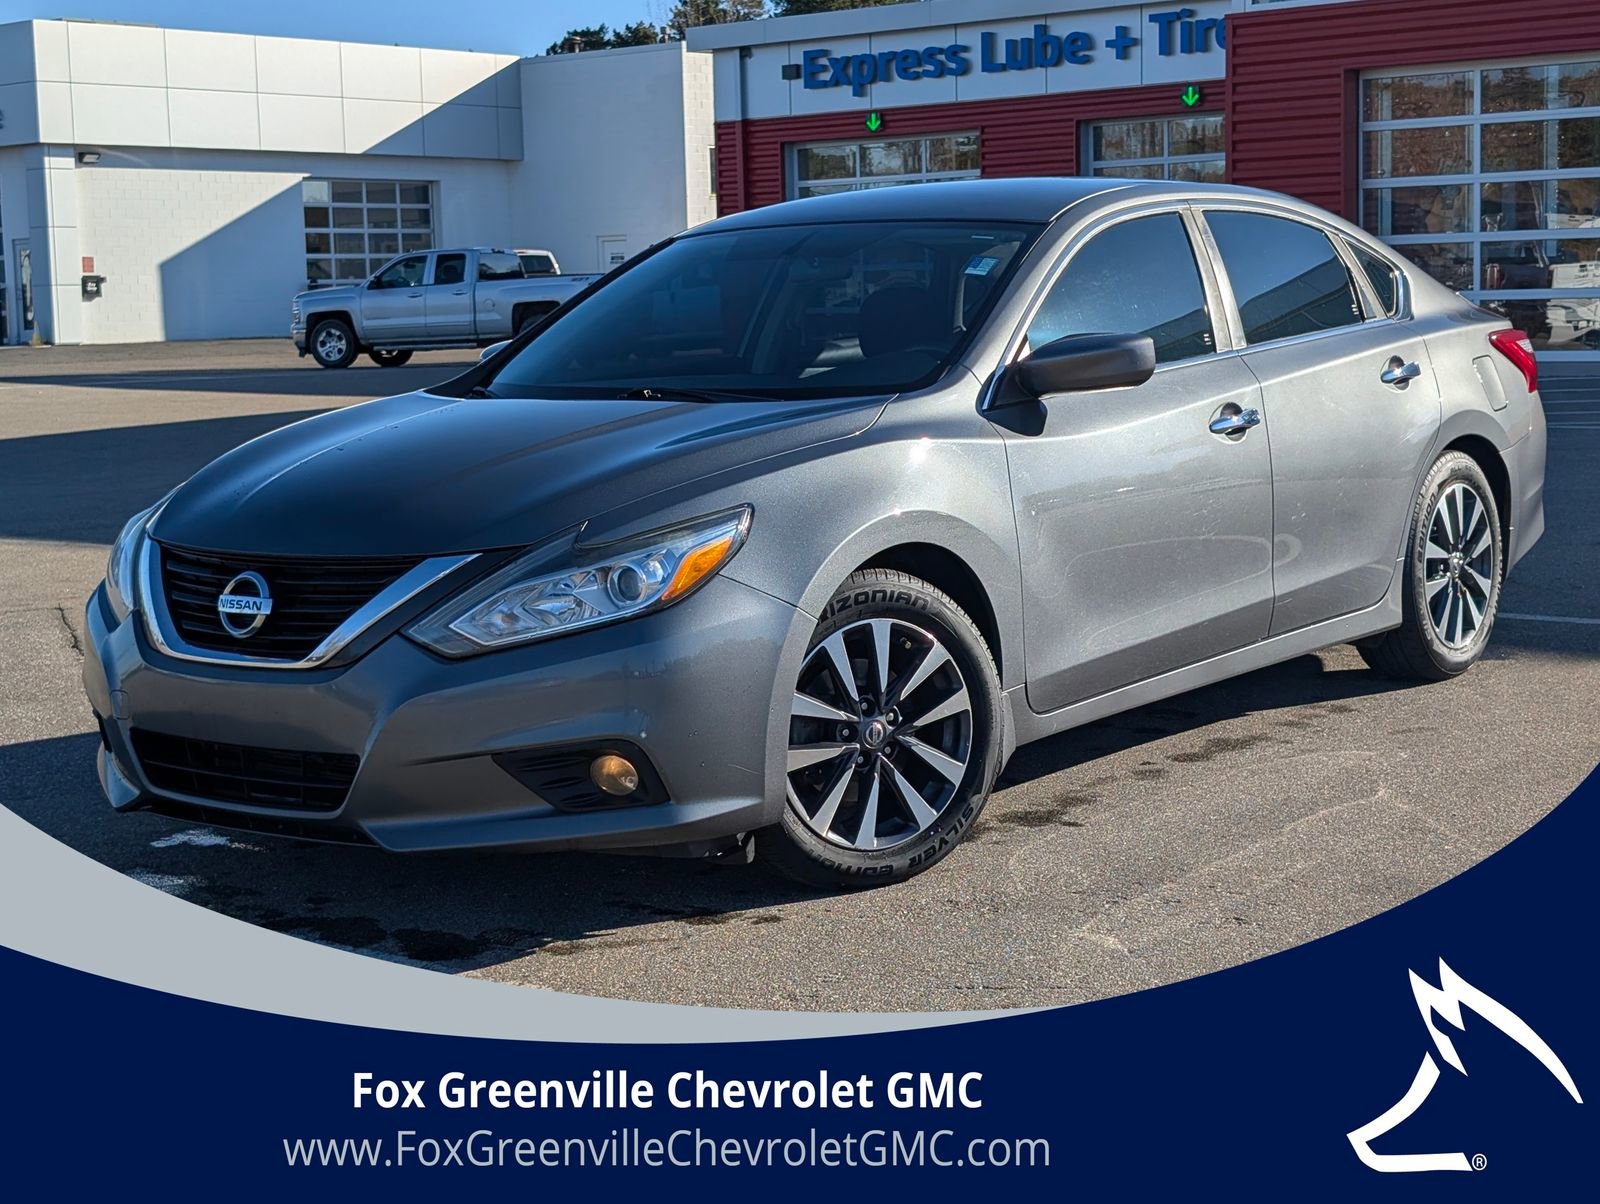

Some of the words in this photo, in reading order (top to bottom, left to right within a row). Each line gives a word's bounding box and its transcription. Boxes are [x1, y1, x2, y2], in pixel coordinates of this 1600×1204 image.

[803, 44, 971, 97] Express
[981, 24, 1093, 72] Lube
[1105, 26, 1139, 60] +
[219, 598, 263, 611] NISSAN
[908, 803, 975, 868] SILVER
